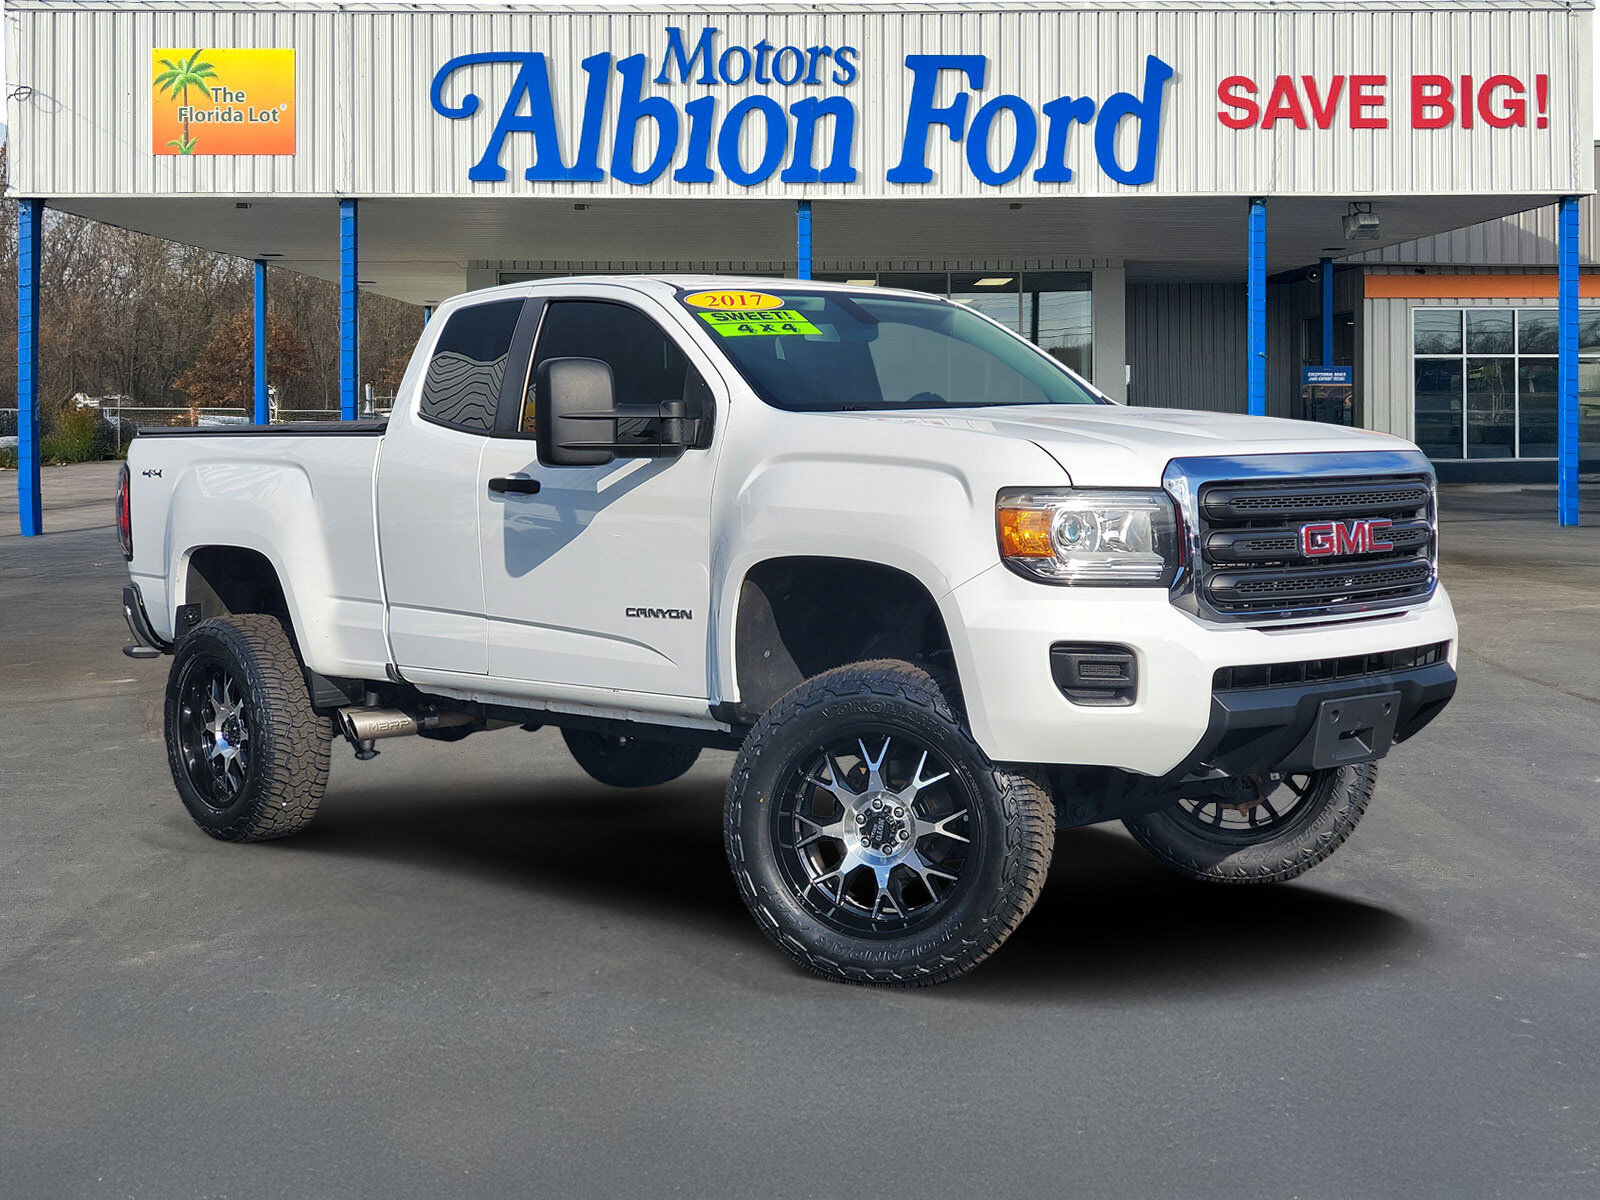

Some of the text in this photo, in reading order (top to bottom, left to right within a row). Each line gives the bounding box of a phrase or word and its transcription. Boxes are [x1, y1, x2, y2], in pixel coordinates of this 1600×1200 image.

[654, 27, 857, 86] Motors
[211, 87, 245, 103] The
[1218, 74, 1548, 129] SAVE BIG!
[178, 107, 280, 122] Florida Lot
[430, 52, 1174, 186] Albion Ford
[704, 294, 762, 307] 2017
[711, 311, 792, 322] SWEET!
[1301, 518, 1394, 558] GMC
[625, 607, 693, 620] CANYON
[367, 718, 411, 733] MBRP
